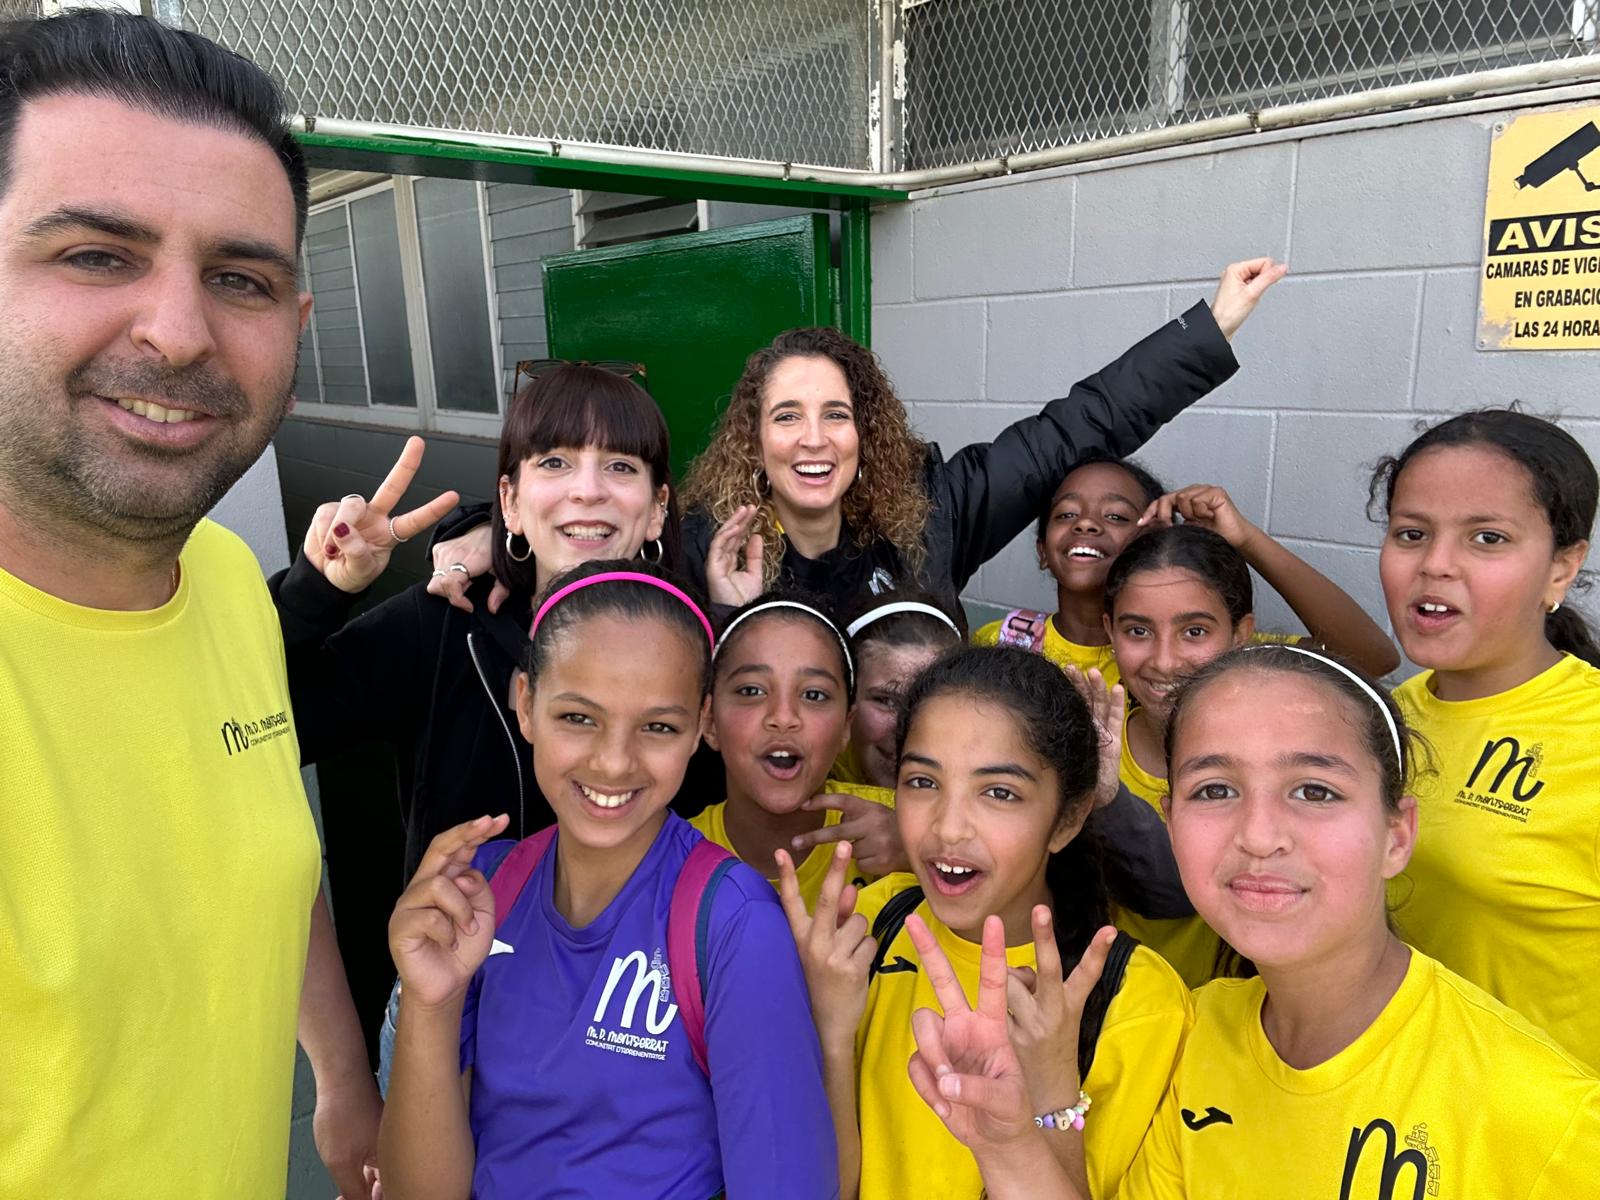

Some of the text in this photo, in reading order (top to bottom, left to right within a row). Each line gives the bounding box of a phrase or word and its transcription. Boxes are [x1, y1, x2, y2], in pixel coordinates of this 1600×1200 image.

[1486, 260, 1548, 279] CAMARAS
[1552, 258, 1570, 275] DE
[1514, 291, 1533, 308] EN
[1514, 321, 1539, 338] LAS
[1543, 321, 1559, 337] 24
[1474, 794, 1531, 817] MONTSERRAT
[585, 1039, 616, 1053] COMUNITAT
[607, 1030, 669, 1053] MONTSERRAT
